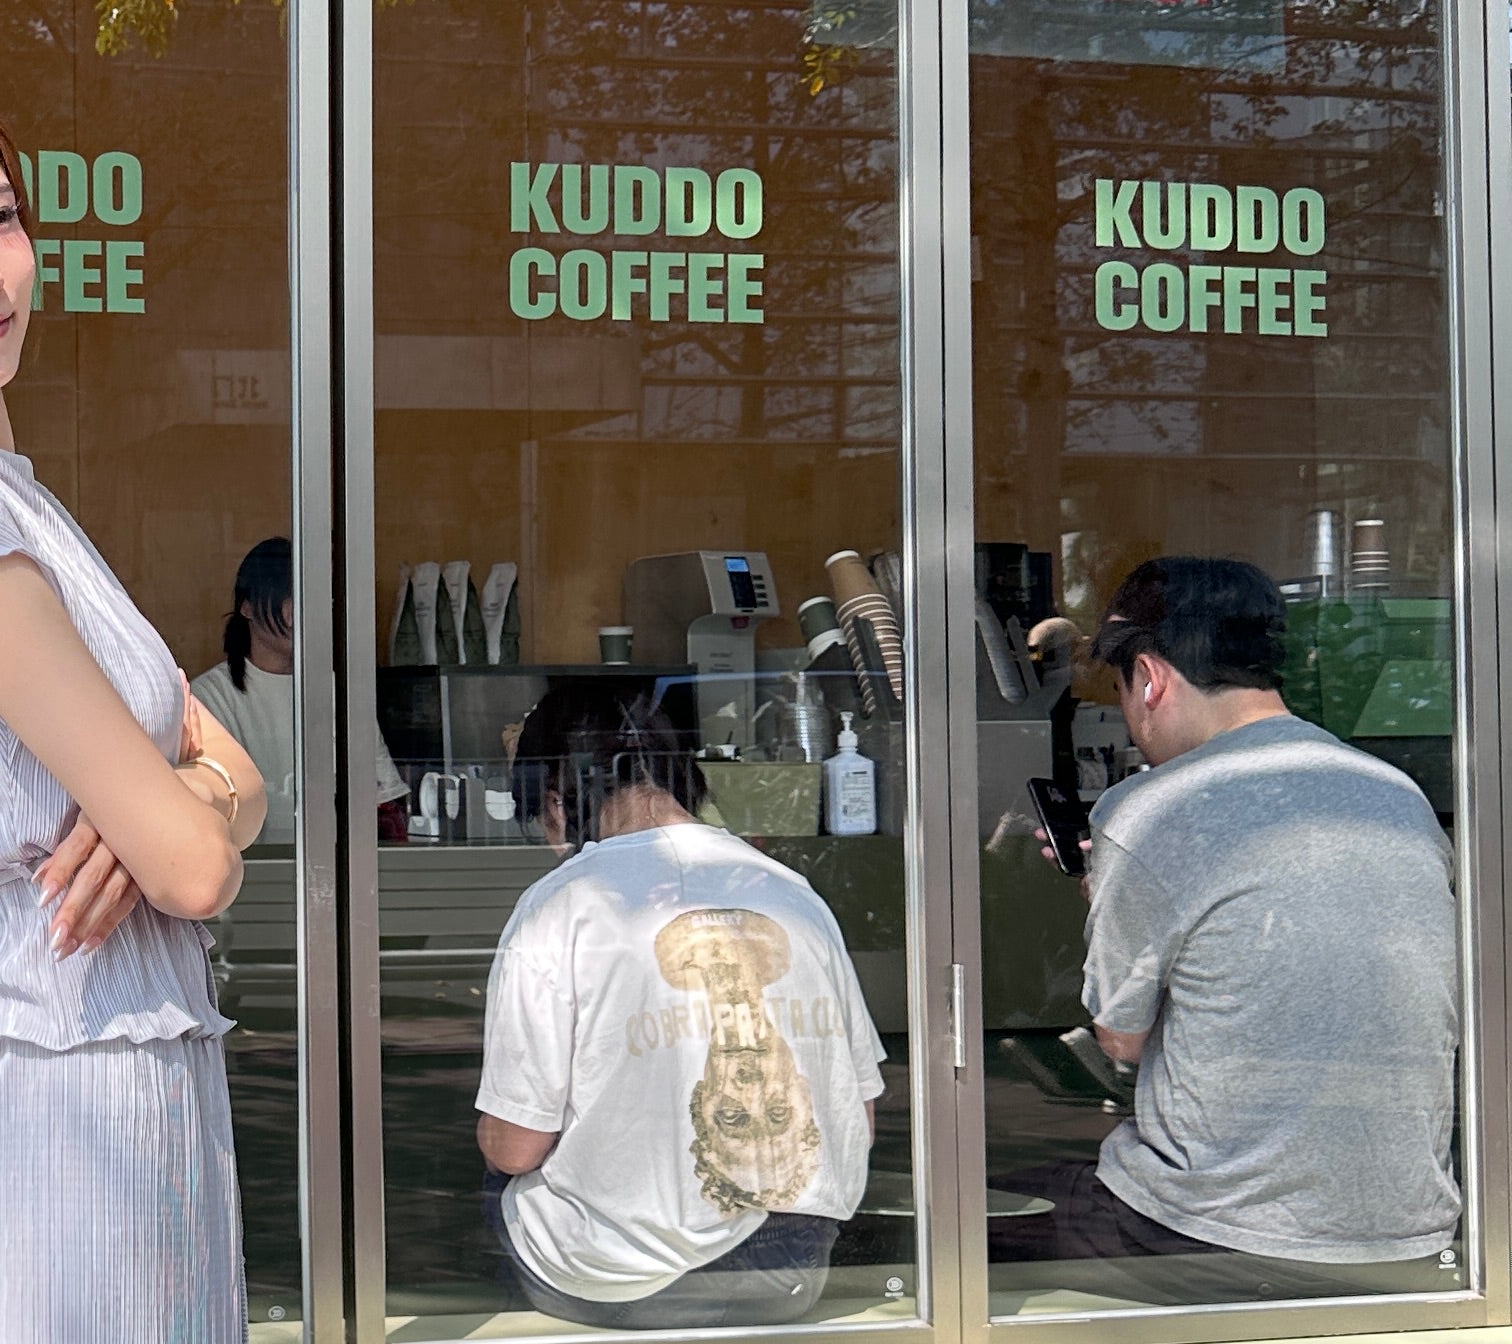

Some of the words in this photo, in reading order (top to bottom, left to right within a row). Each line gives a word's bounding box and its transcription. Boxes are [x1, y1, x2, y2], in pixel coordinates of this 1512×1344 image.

[19, 150, 143, 226] DO
[510, 162, 765, 239] KUDDO
[1095, 179, 1327, 256] KUDDO
[509, 248, 767, 324] COFFEE
[1095, 262, 1329, 337] COFFEE
